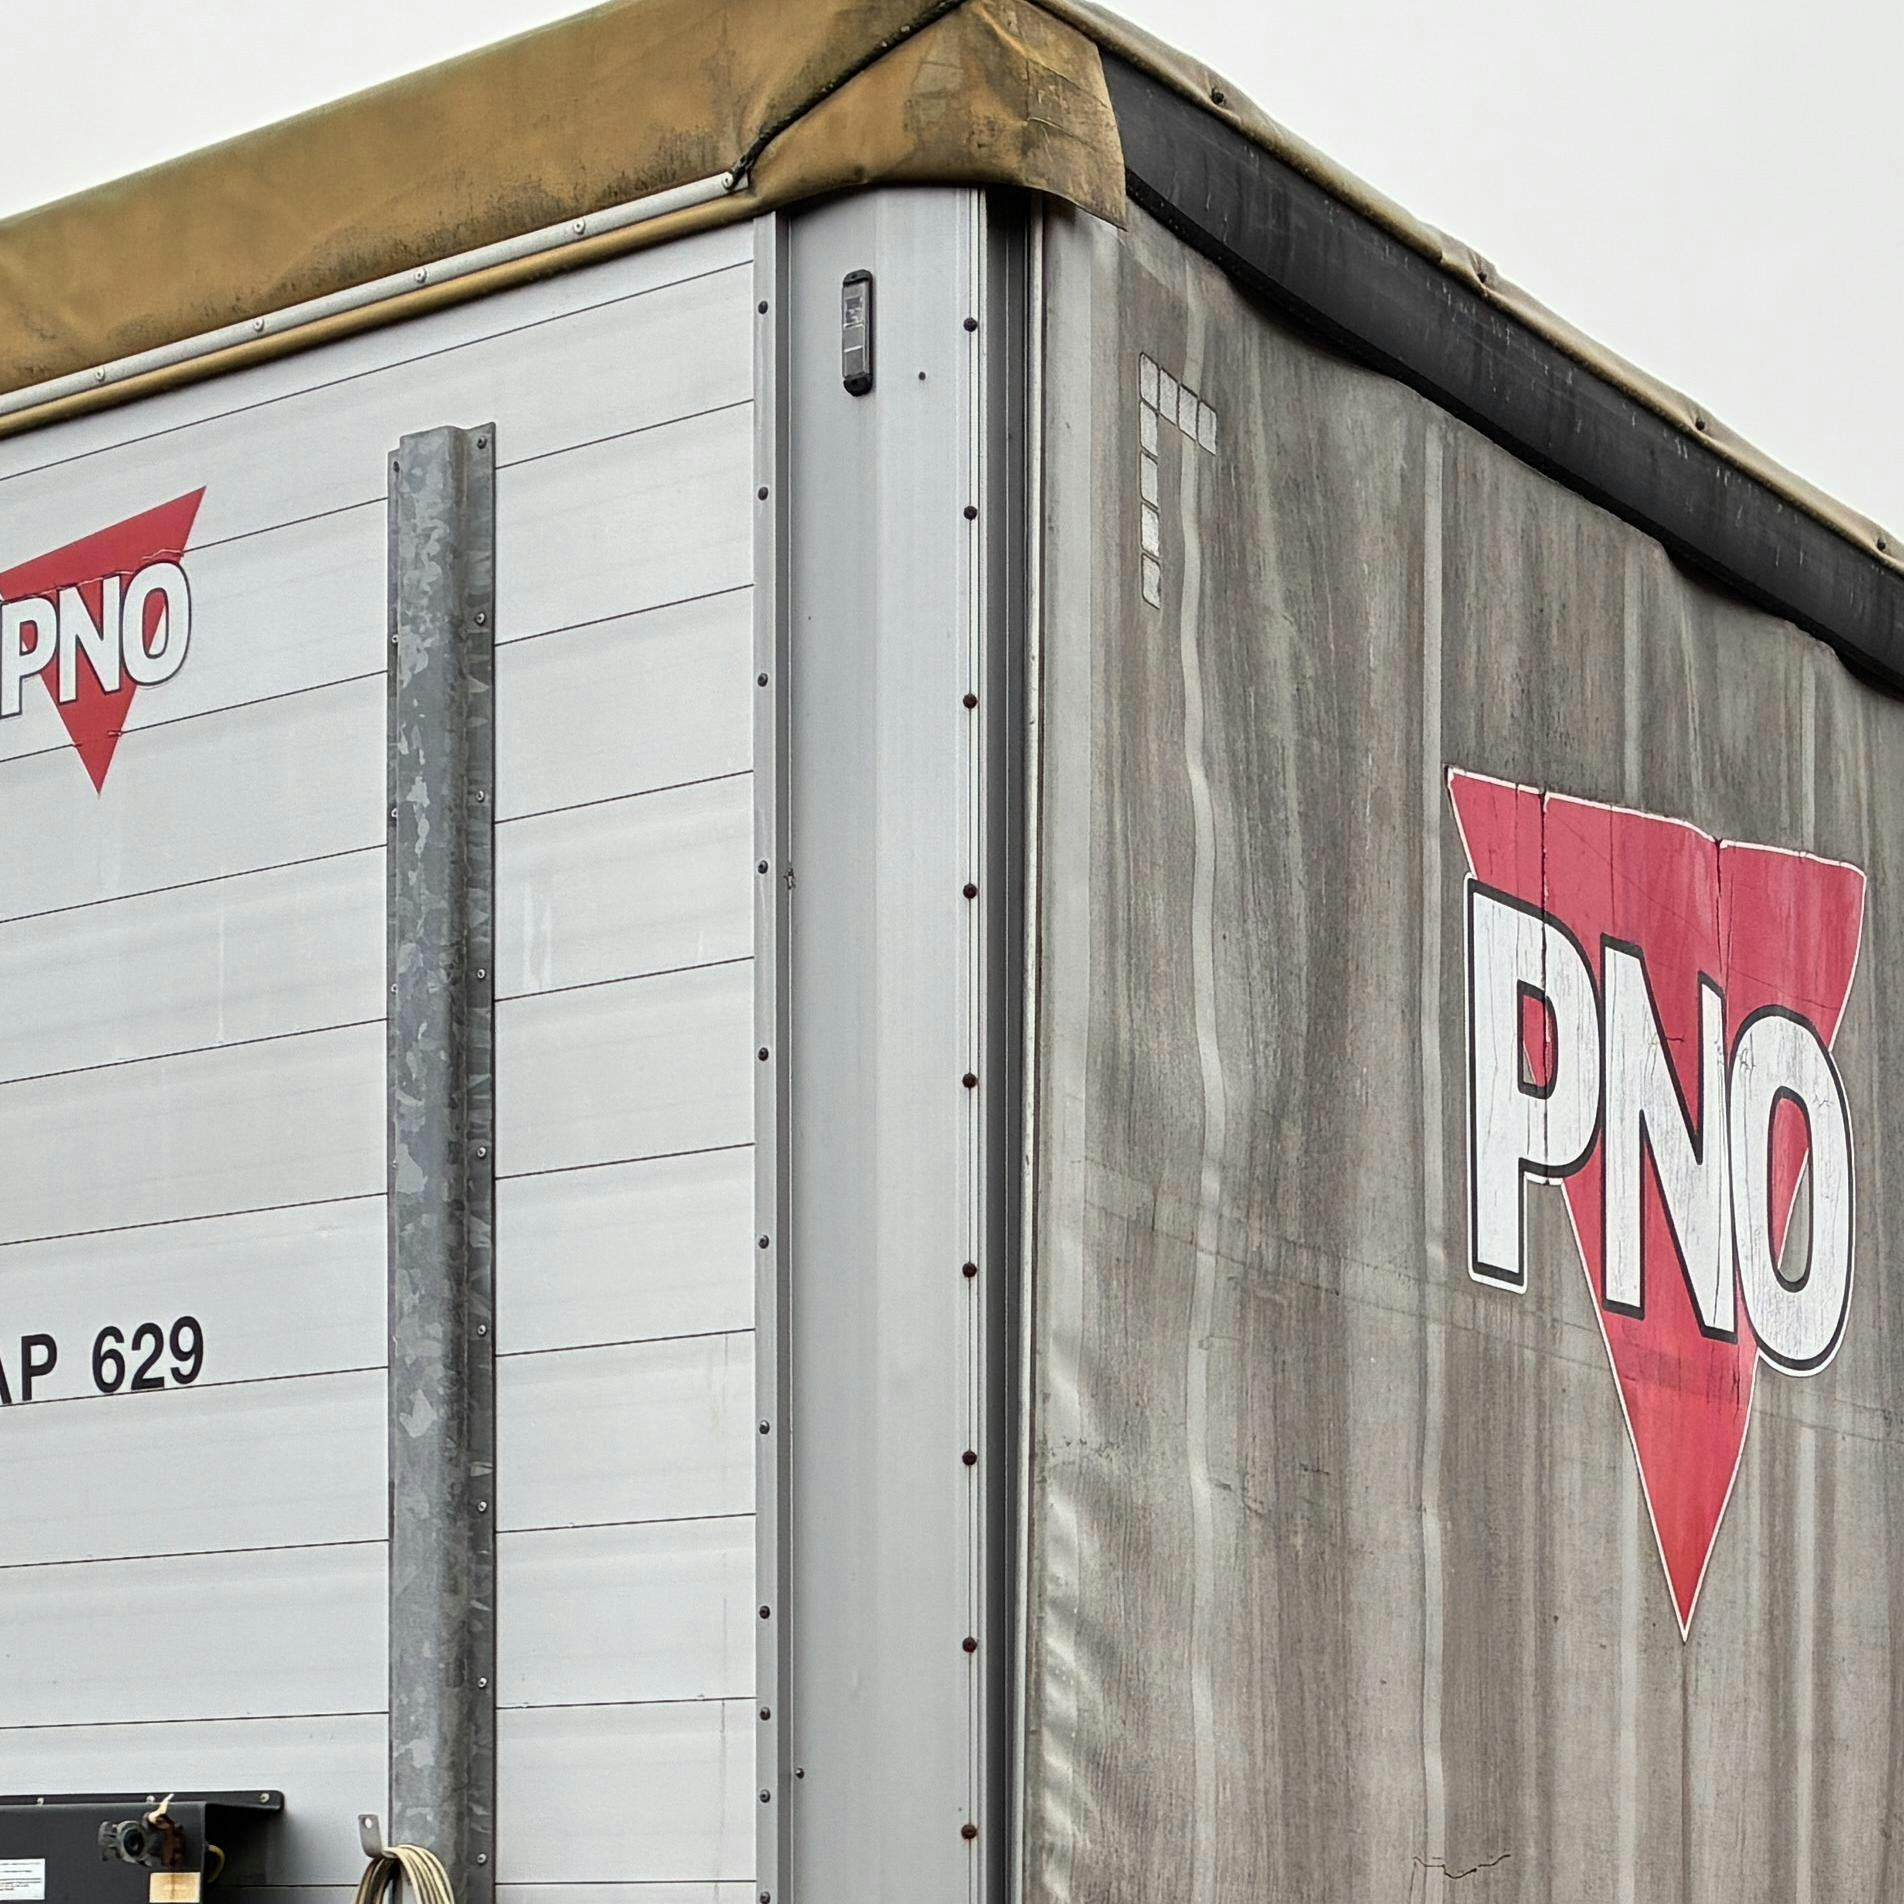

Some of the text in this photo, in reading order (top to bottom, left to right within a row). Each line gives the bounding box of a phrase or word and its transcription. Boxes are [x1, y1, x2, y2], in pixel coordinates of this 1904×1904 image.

[0, 558, 192, 720] PNO
[1465, 874, 1856, 1376] PNO
[92, 1315, 204, 1394] 629
